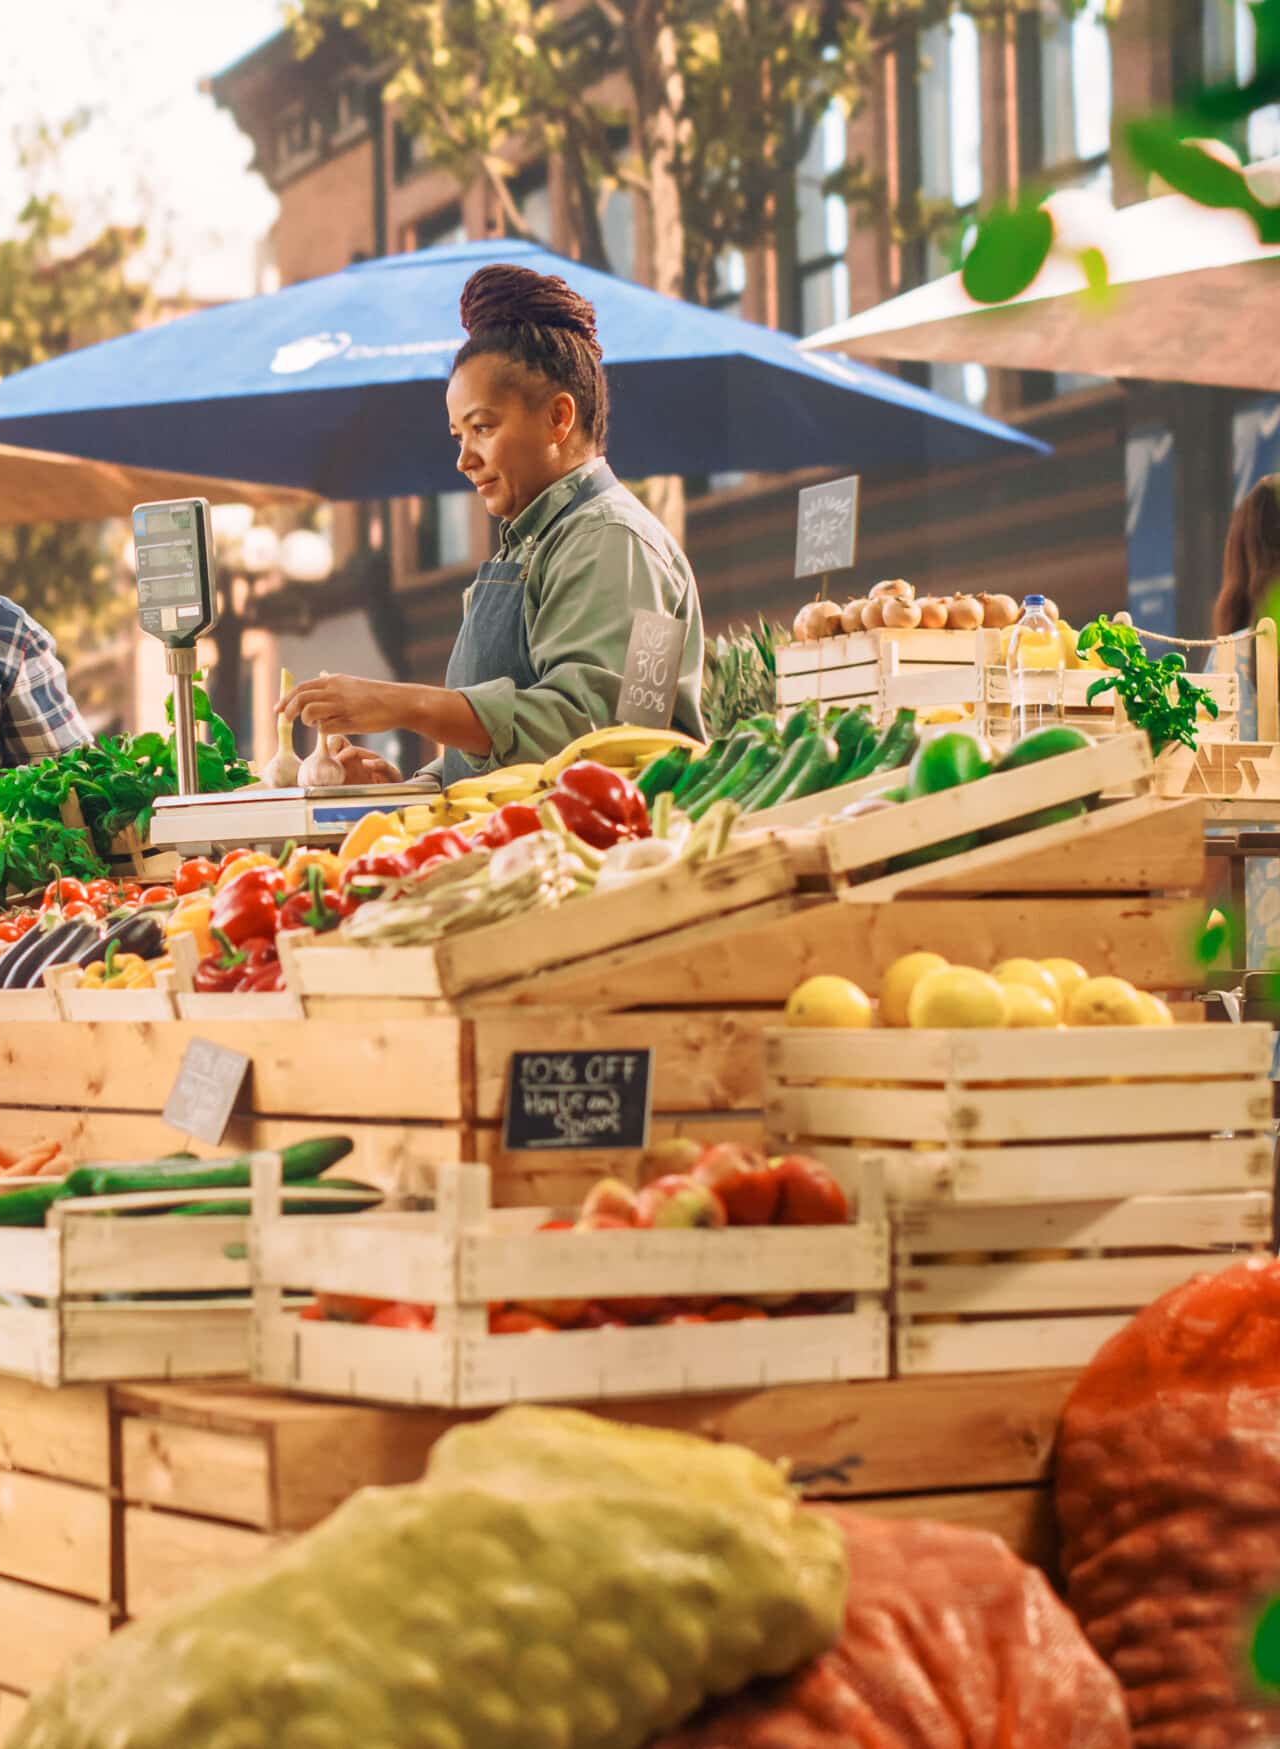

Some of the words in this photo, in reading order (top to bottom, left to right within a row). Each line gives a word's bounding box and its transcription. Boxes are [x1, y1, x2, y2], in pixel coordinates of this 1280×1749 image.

[635, 649, 668, 686] BIO
[626, 684, 666, 713] 100%
[520, 1056, 577, 1083] 10%
[584, 1054, 637, 1083] OFF
